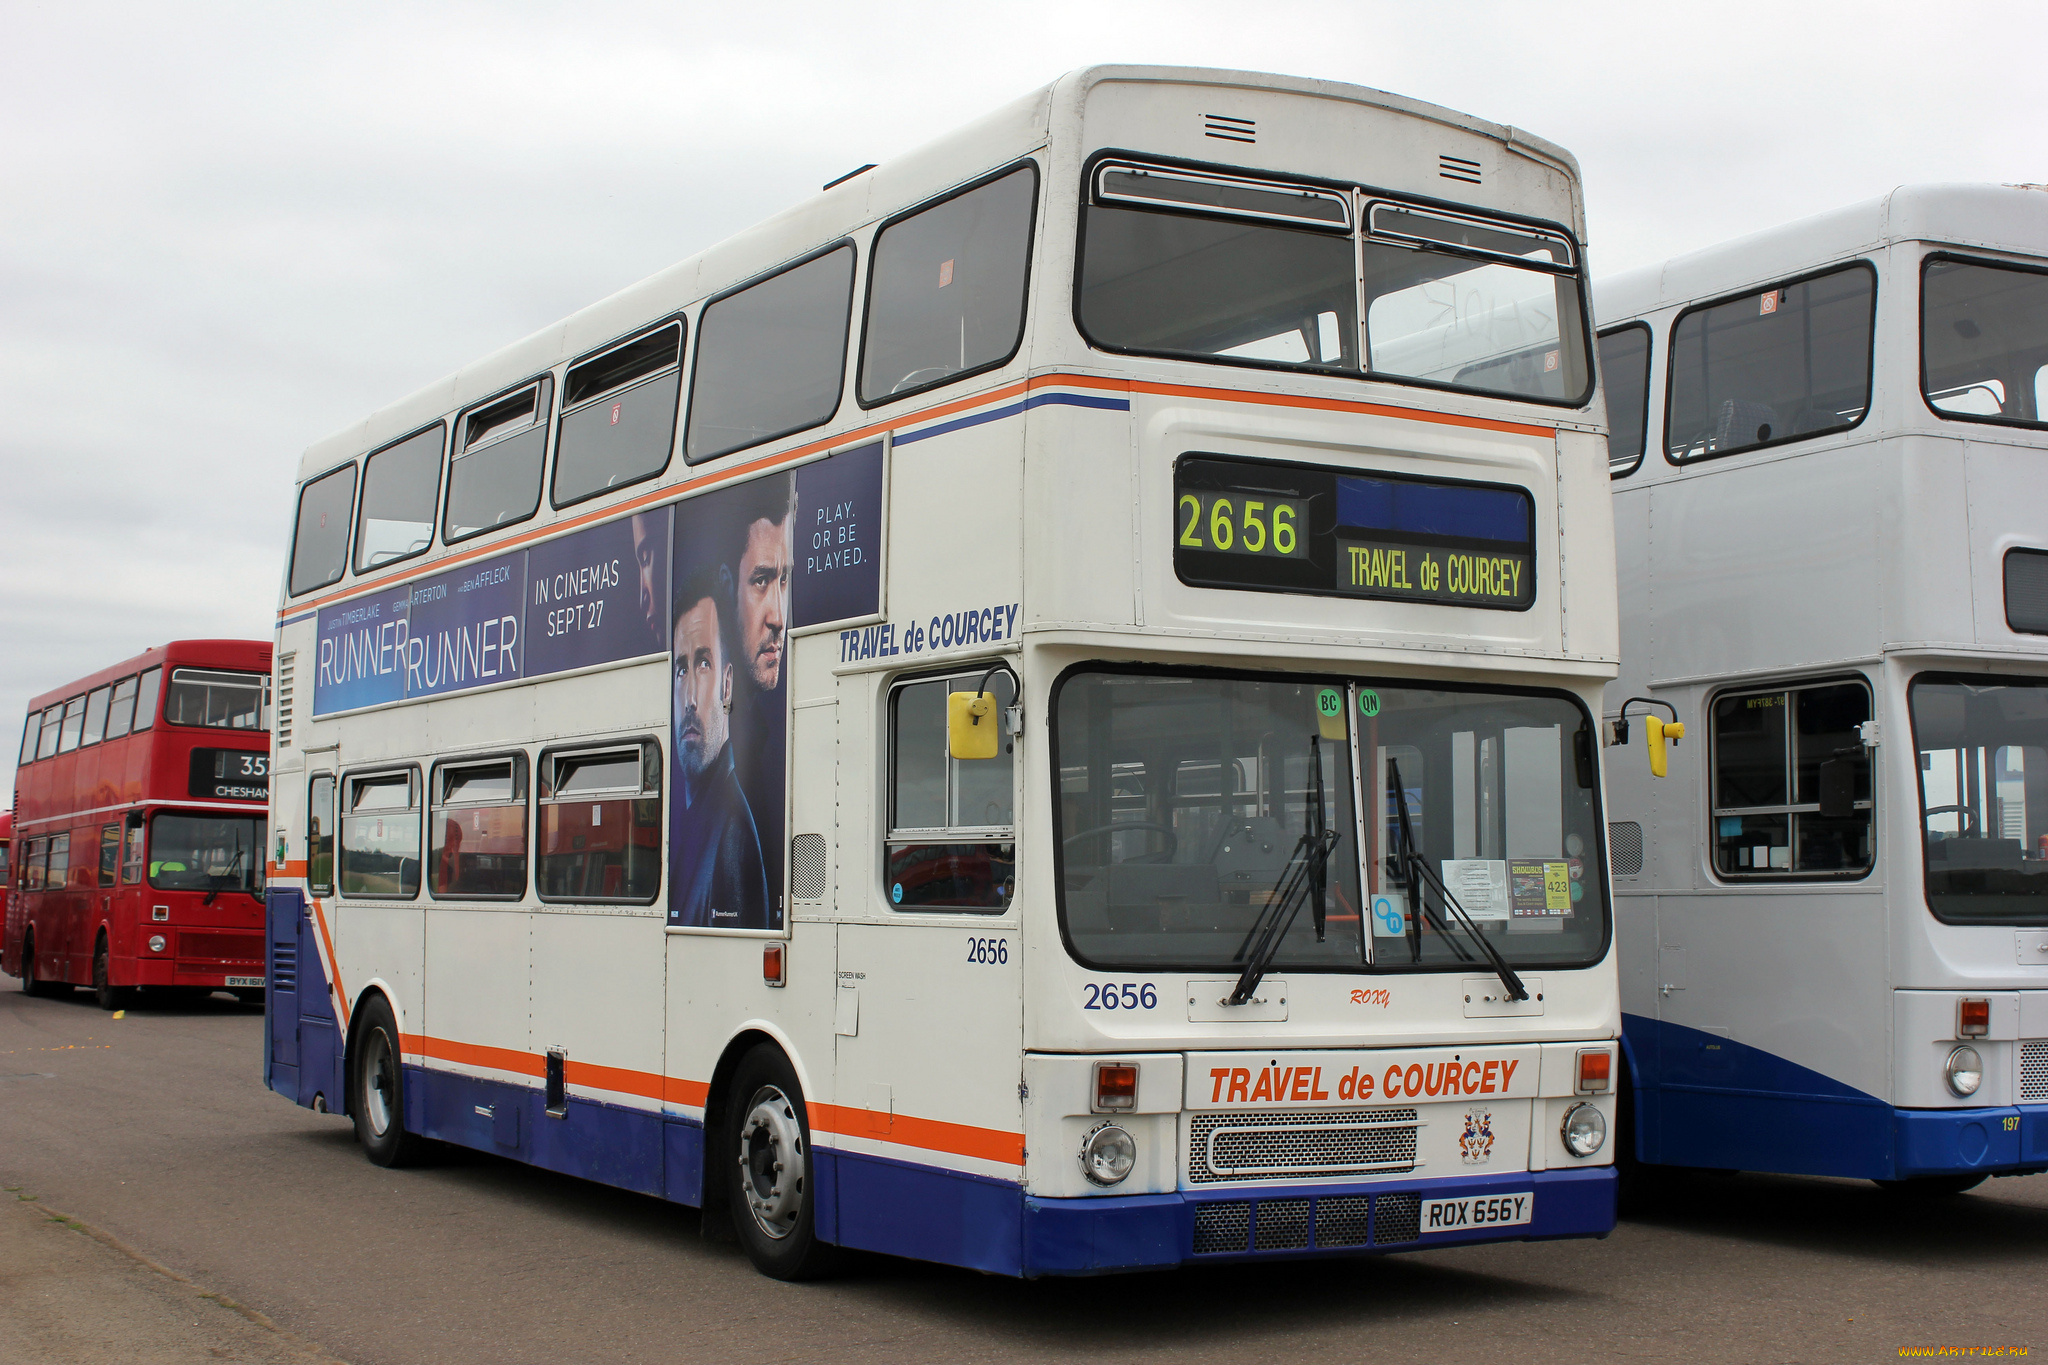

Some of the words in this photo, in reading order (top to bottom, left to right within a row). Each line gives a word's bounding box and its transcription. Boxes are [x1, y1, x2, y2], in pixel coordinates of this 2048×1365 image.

[817, 501, 855, 526] PLAY.
[1180, 494, 1296, 554] 2656
[812, 530, 831, 550] OR
[838, 523, 856, 544] BE
[807, 547, 867, 575] PLAYED.
[1347, 546, 1412, 589] TRAVEL
[1420, 552, 1440, 591] de
[1447, 553, 1522, 597] COURCEY
[475, 565, 511, 589] AFFLECK
[535, 577, 549, 605] IN
[554, 559, 619, 600] CINEMAS
[547, 604, 584, 637] SEPT
[587, 600, 604, 629] 27
[840, 623, 899, 662] TRAVEL
[904, 620, 924, 654] de
[929, 603, 1019, 650] COURCEY
[319, 618, 408, 687] RUNNER
[408, 615, 518, 692] RUNNER
[1321, 695, 1337, 711] BC
[1362, 695, 1378, 713] QN
[240, 756, 269, 776] 35
[1548, 881, 1567, 893] 423
[967, 937, 1008, 965] 2656
[838, 971, 854, 979] SCREEN
[1083, 983, 1157, 1010] 2656
[1350, 988, 1390, 1009] ROXY
[1209, 1066, 1329, 1103] TRAVEL
[1338, 1066, 1375, 1100] de
[1383, 1060, 1519, 1099] COURCEY
[2002, 1117, 2020, 1131] 197
[1429, 1201, 1469, 1227] ROX
[1473, 1197, 1525, 1223] 656Y
